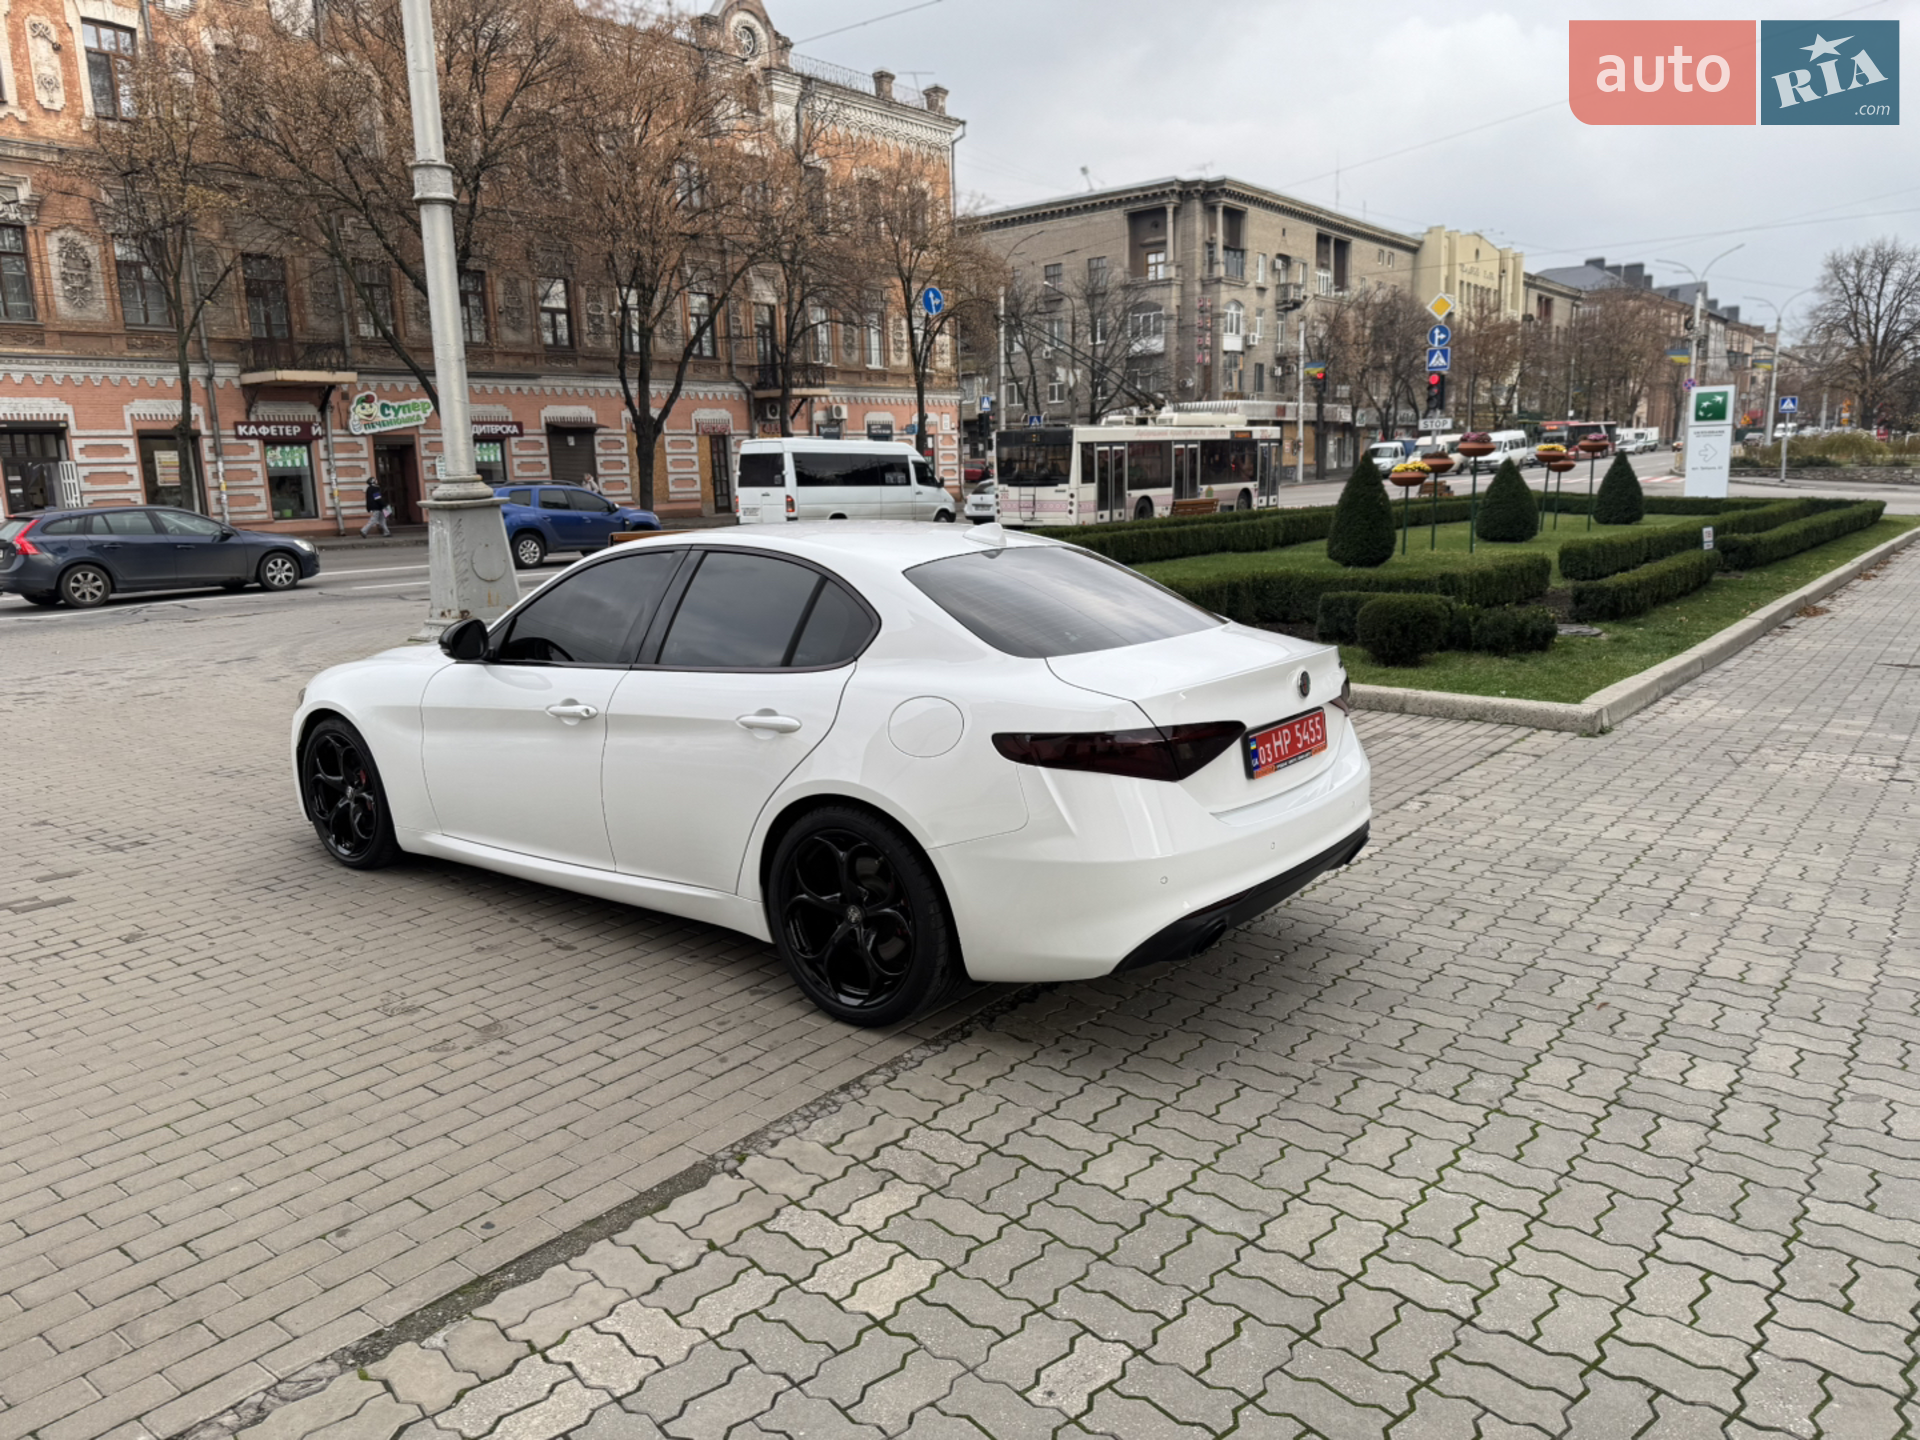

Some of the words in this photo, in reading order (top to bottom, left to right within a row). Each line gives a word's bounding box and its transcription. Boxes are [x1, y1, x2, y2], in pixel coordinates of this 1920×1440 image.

[380, 401, 431, 418] Супер
[1422, 419, 1449, 429] STOP
[1294, 716, 1323, 749] 5455
